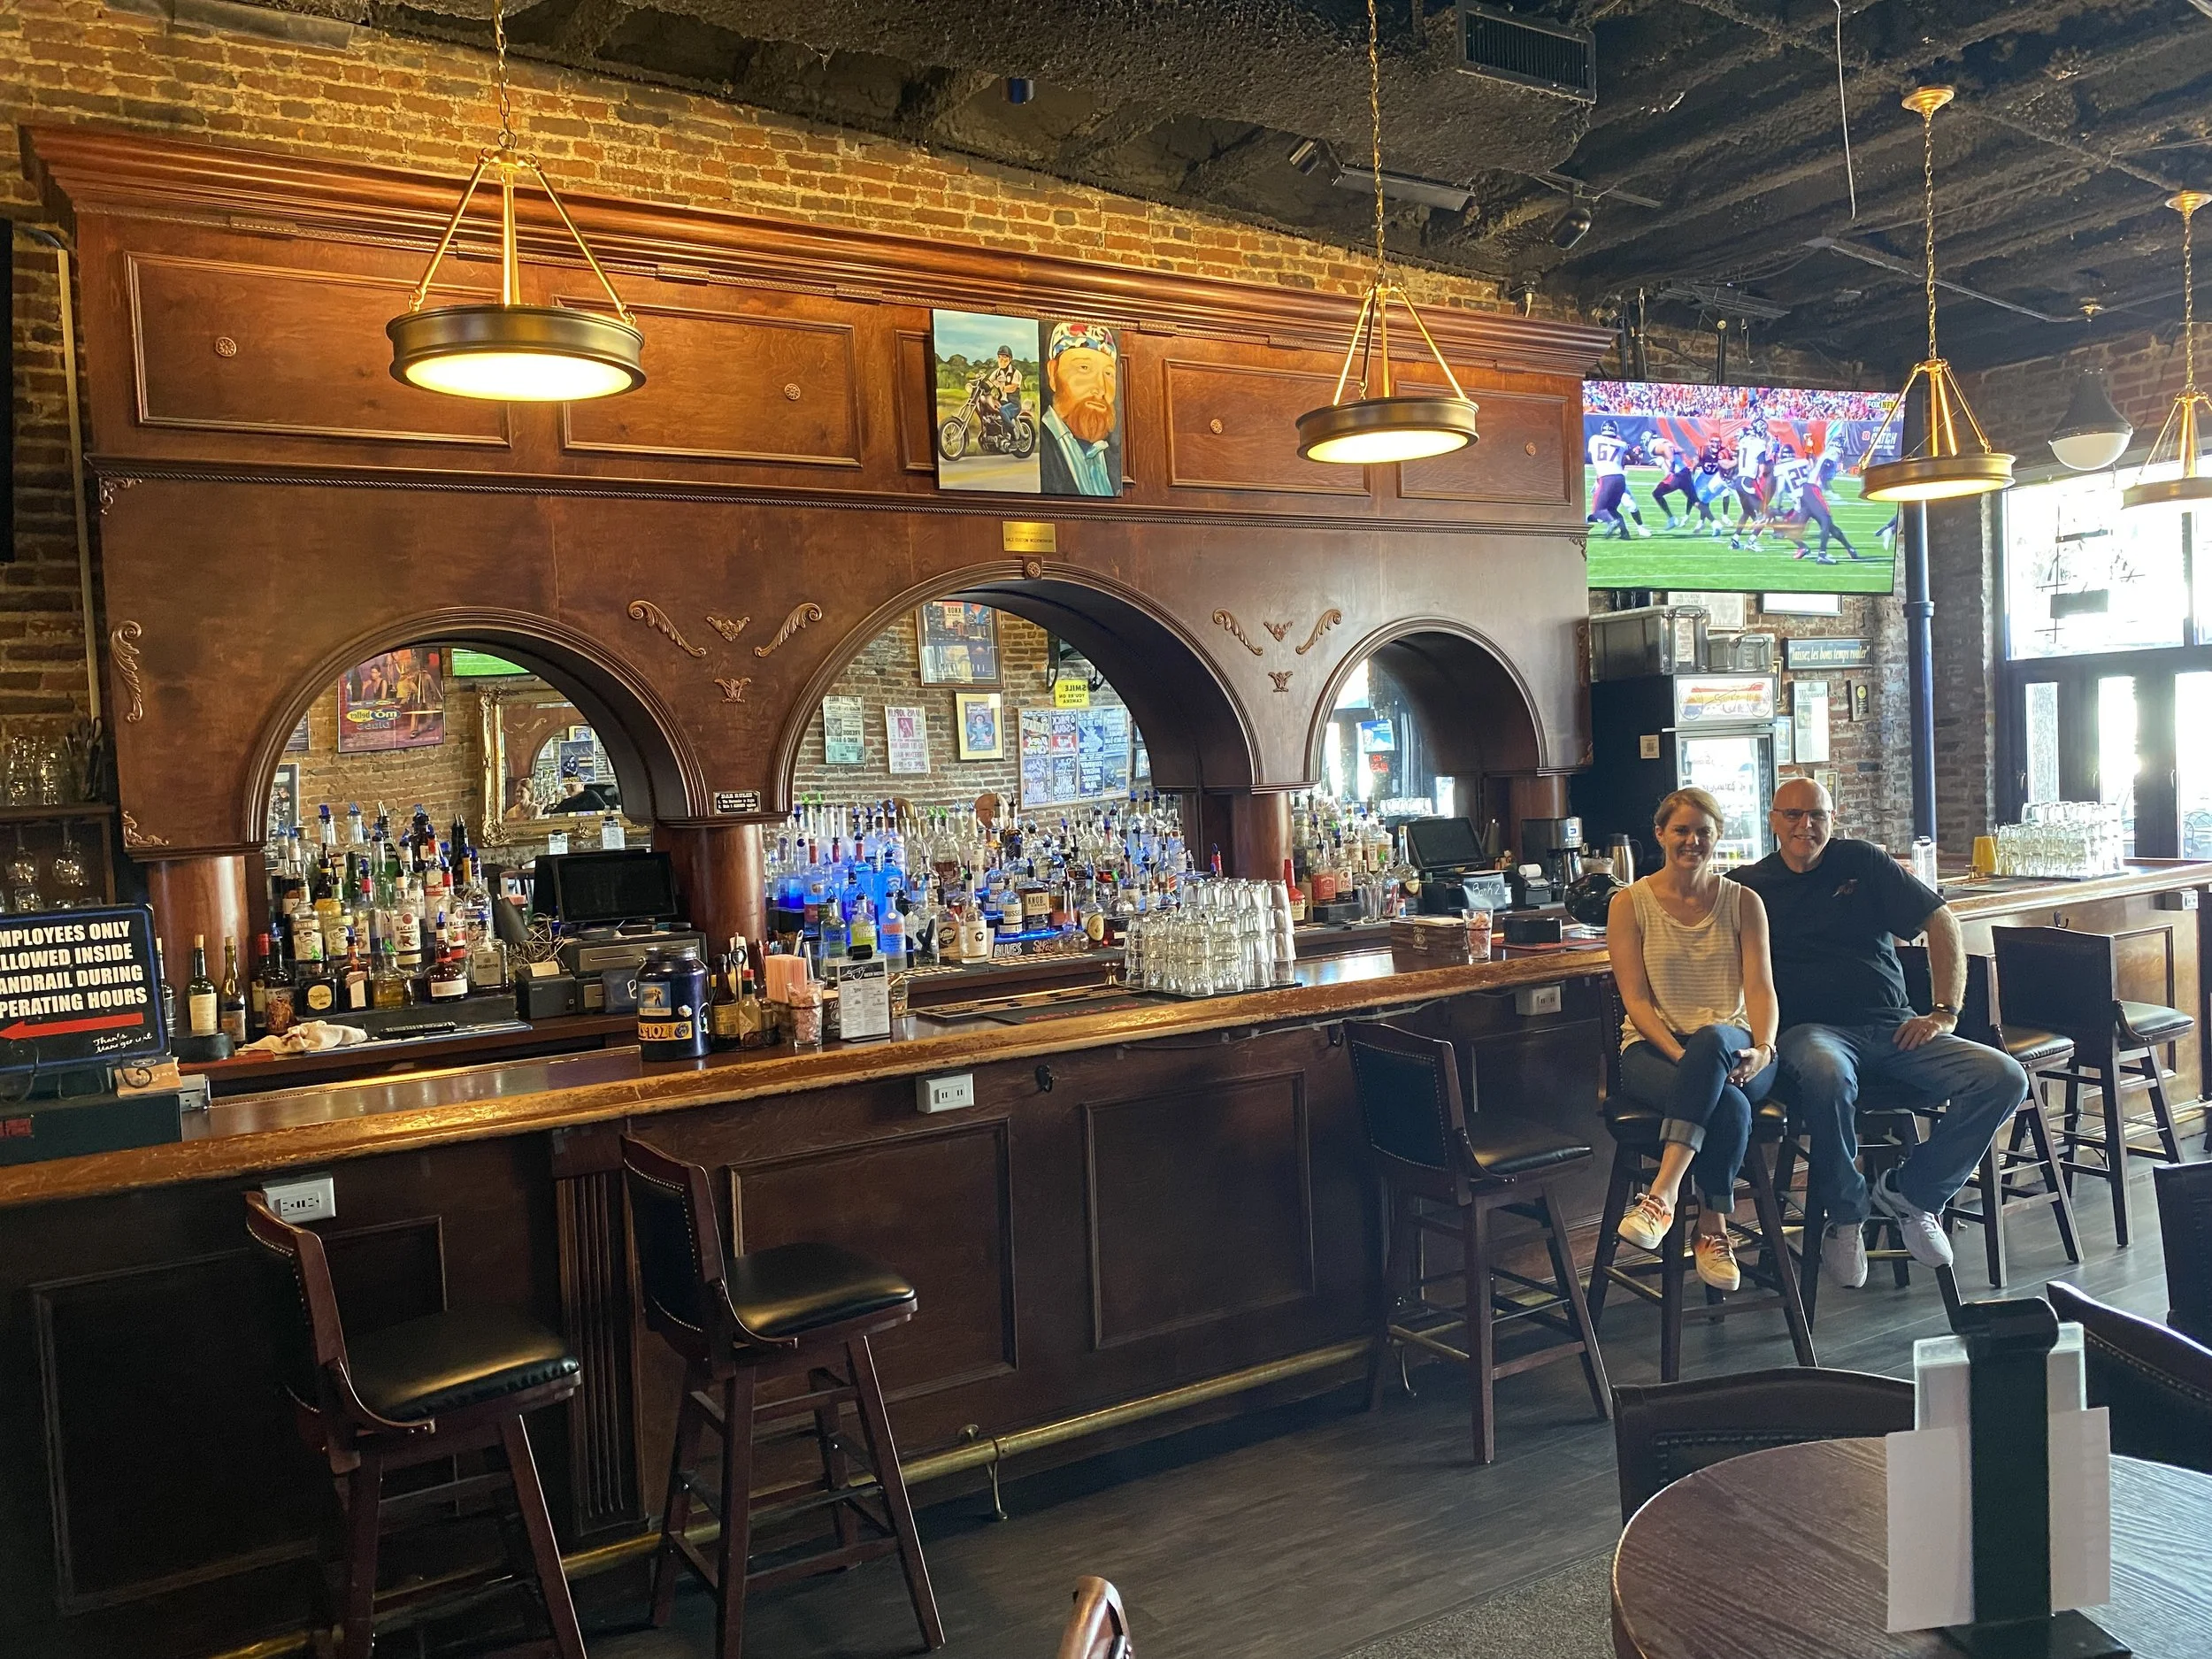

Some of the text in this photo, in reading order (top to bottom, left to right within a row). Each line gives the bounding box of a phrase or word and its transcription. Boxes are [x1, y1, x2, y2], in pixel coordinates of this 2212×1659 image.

[1867, 400, 1881, 409] FOX
[1597, 442, 1619, 462] 67
[1703, 463, 1718, 472] 57
[1787, 465, 1809, 489] 25
[1495, 885, 1502, 895] 2
[88, 920, 130, 940] ONLY
[0, 943, 134, 972] LLOWED INSIDE
[995, 941, 1022, 957] BLUES
[76, 964, 143, 987] DURING
[87, 987, 148, 1009] HOURS
